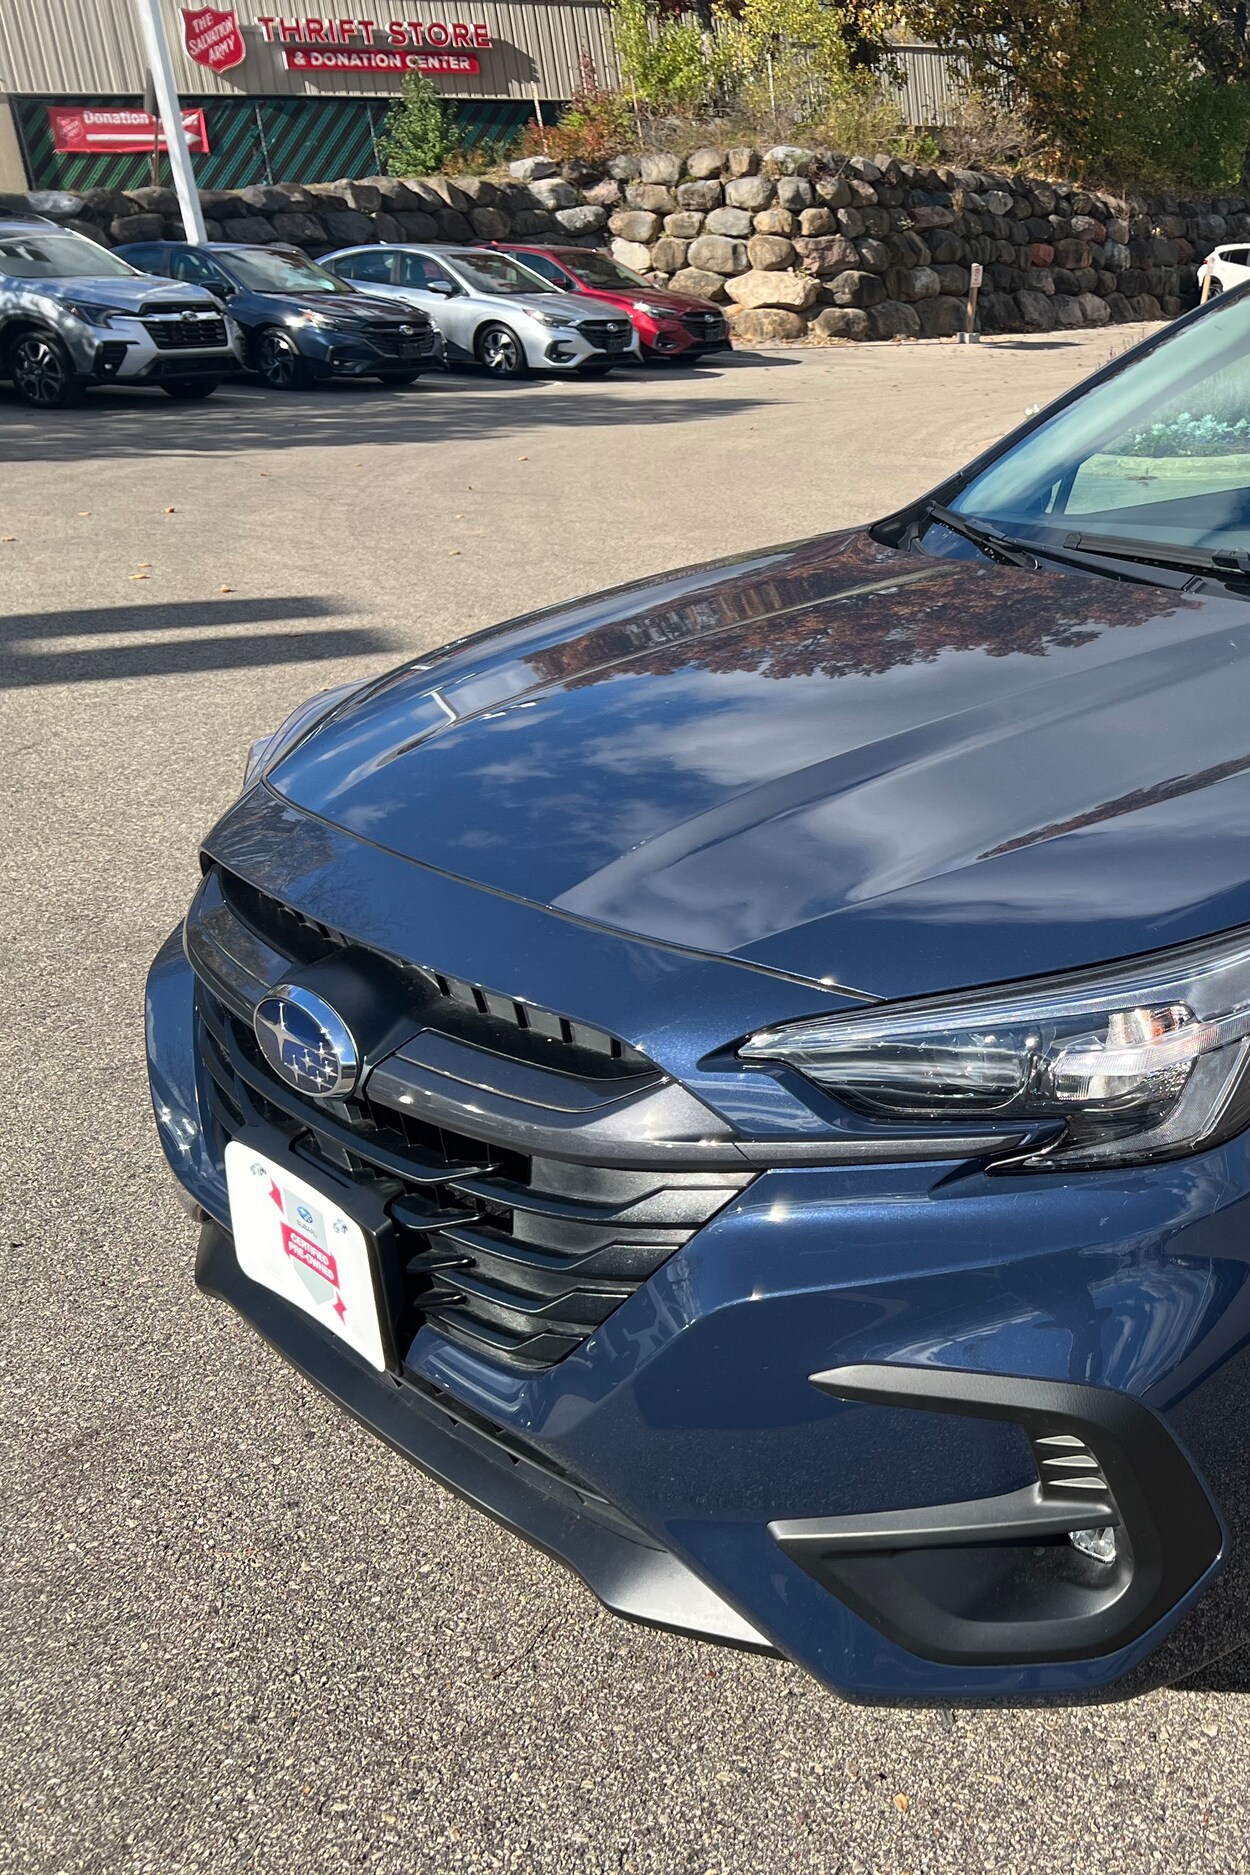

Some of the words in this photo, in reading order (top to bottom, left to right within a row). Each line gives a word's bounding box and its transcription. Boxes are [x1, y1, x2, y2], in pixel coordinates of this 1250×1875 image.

[188, 16, 234, 55] SALVATION
[192, 12, 214, 33] THE
[256, 16, 375, 46] THRIFT
[387, 20, 493, 49] STORE
[207, 34, 235, 64] ARMY
[294, 51, 306, 66] &
[310, 52, 402, 68] DONATION
[406, 53, 470, 70] CENTER
[83, 110, 150, 124] Donation
[288, 1241, 334, 1281] PRE-OWNED
[290, 1232, 330, 1266] CERTIFIED
